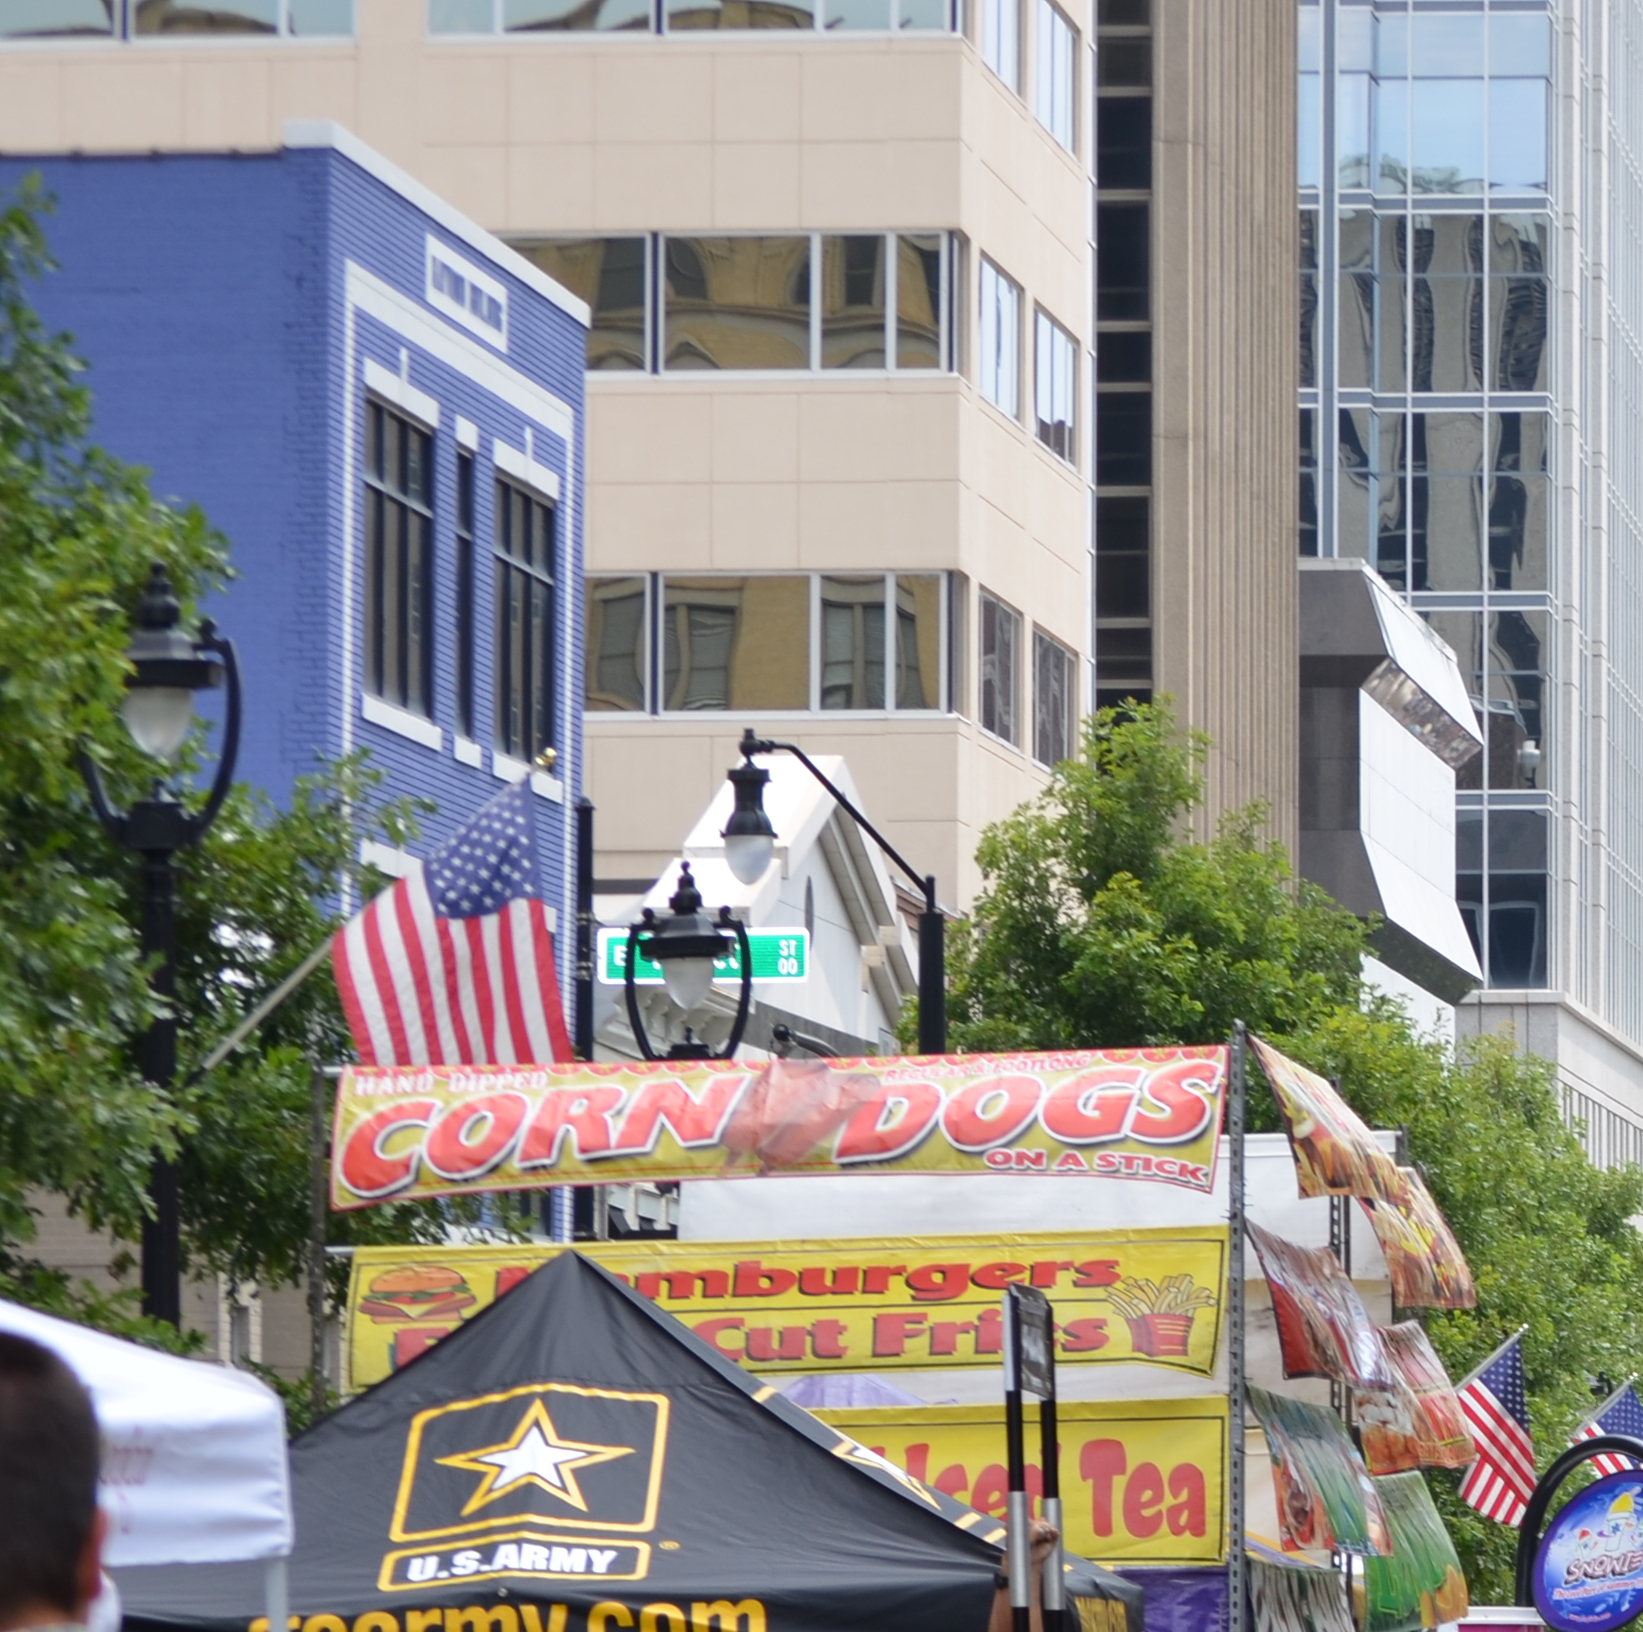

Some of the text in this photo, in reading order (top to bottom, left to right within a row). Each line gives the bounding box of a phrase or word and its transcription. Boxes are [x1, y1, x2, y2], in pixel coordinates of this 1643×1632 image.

[778, 939, 798, 957] ST
[355, 1069, 549, 1096] HAND DIPPED
[336, 1059, 1223, 1199] CORN DOGS
[983, 1147, 1210, 1186] ON A STICK
[496, 1257, 1122, 1303] mburgers
[689, 1308, 1111, 1362] Cut Fris
[1079, 1438, 1206, 1539] Tea
